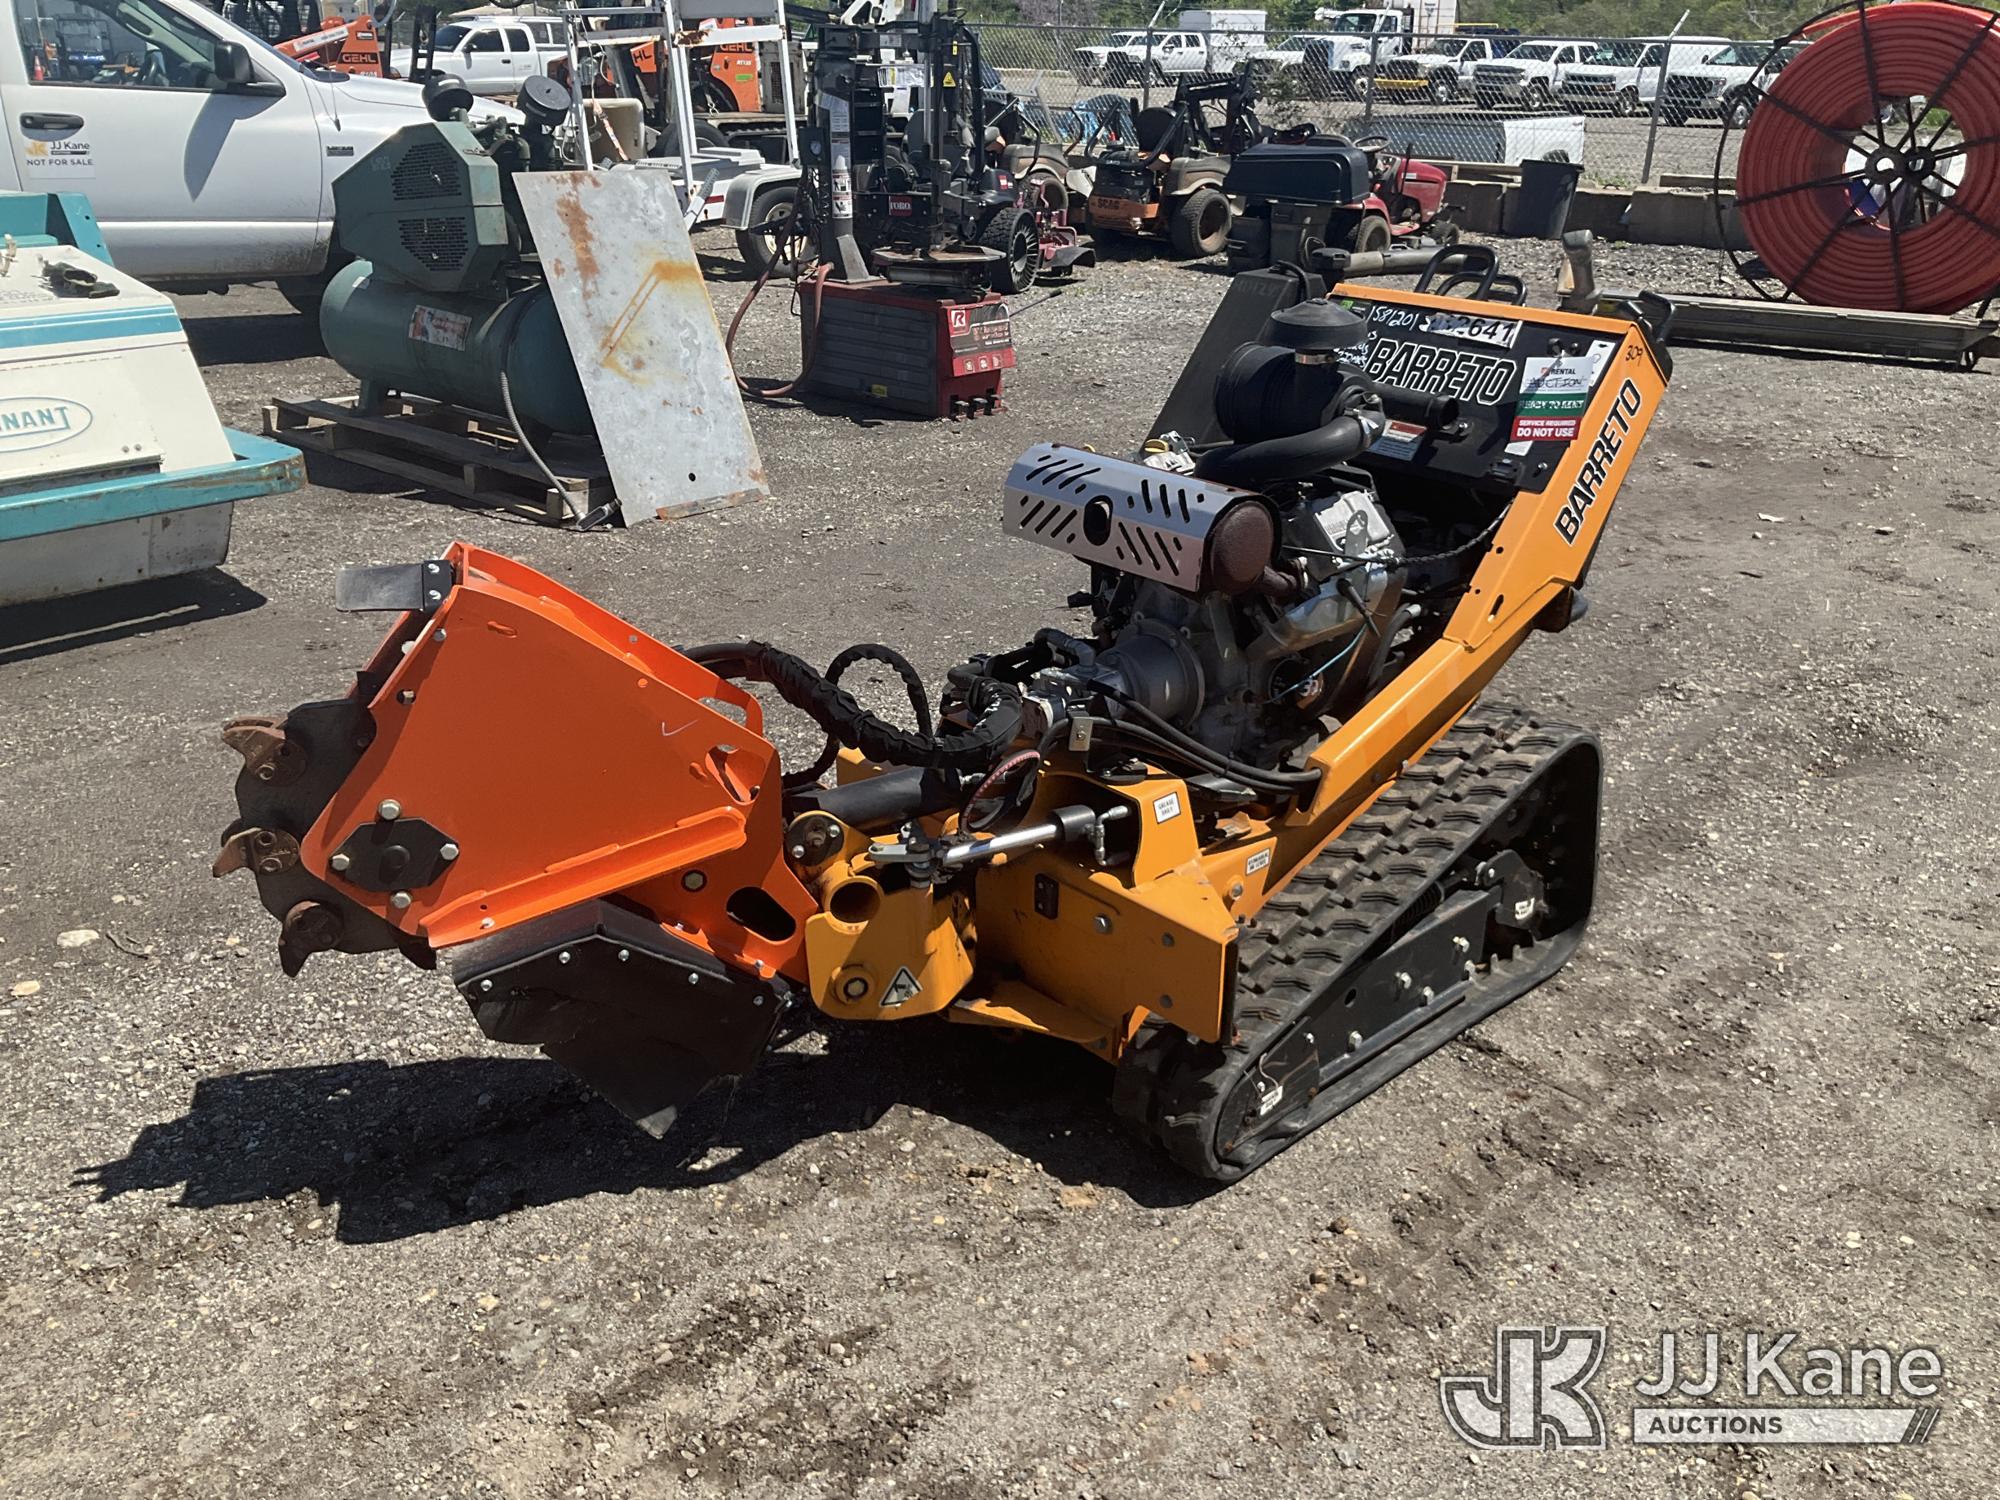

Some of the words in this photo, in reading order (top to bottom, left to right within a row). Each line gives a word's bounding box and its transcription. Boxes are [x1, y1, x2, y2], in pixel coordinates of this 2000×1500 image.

[342, 54, 376, 63] GEHL
[50, 141, 61, 150] JJ
[64, 141, 90, 150] Kane
[1363, 338, 1517, 406] BARRETO
[1550, 367, 1576, 375] RENTAL
[1517, 428, 1531, 437] DO
[1533, 428, 1554, 437] NOT
[1555, 428, 1575, 437] USE
[1553, 378, 1641, 546] BARRETO
